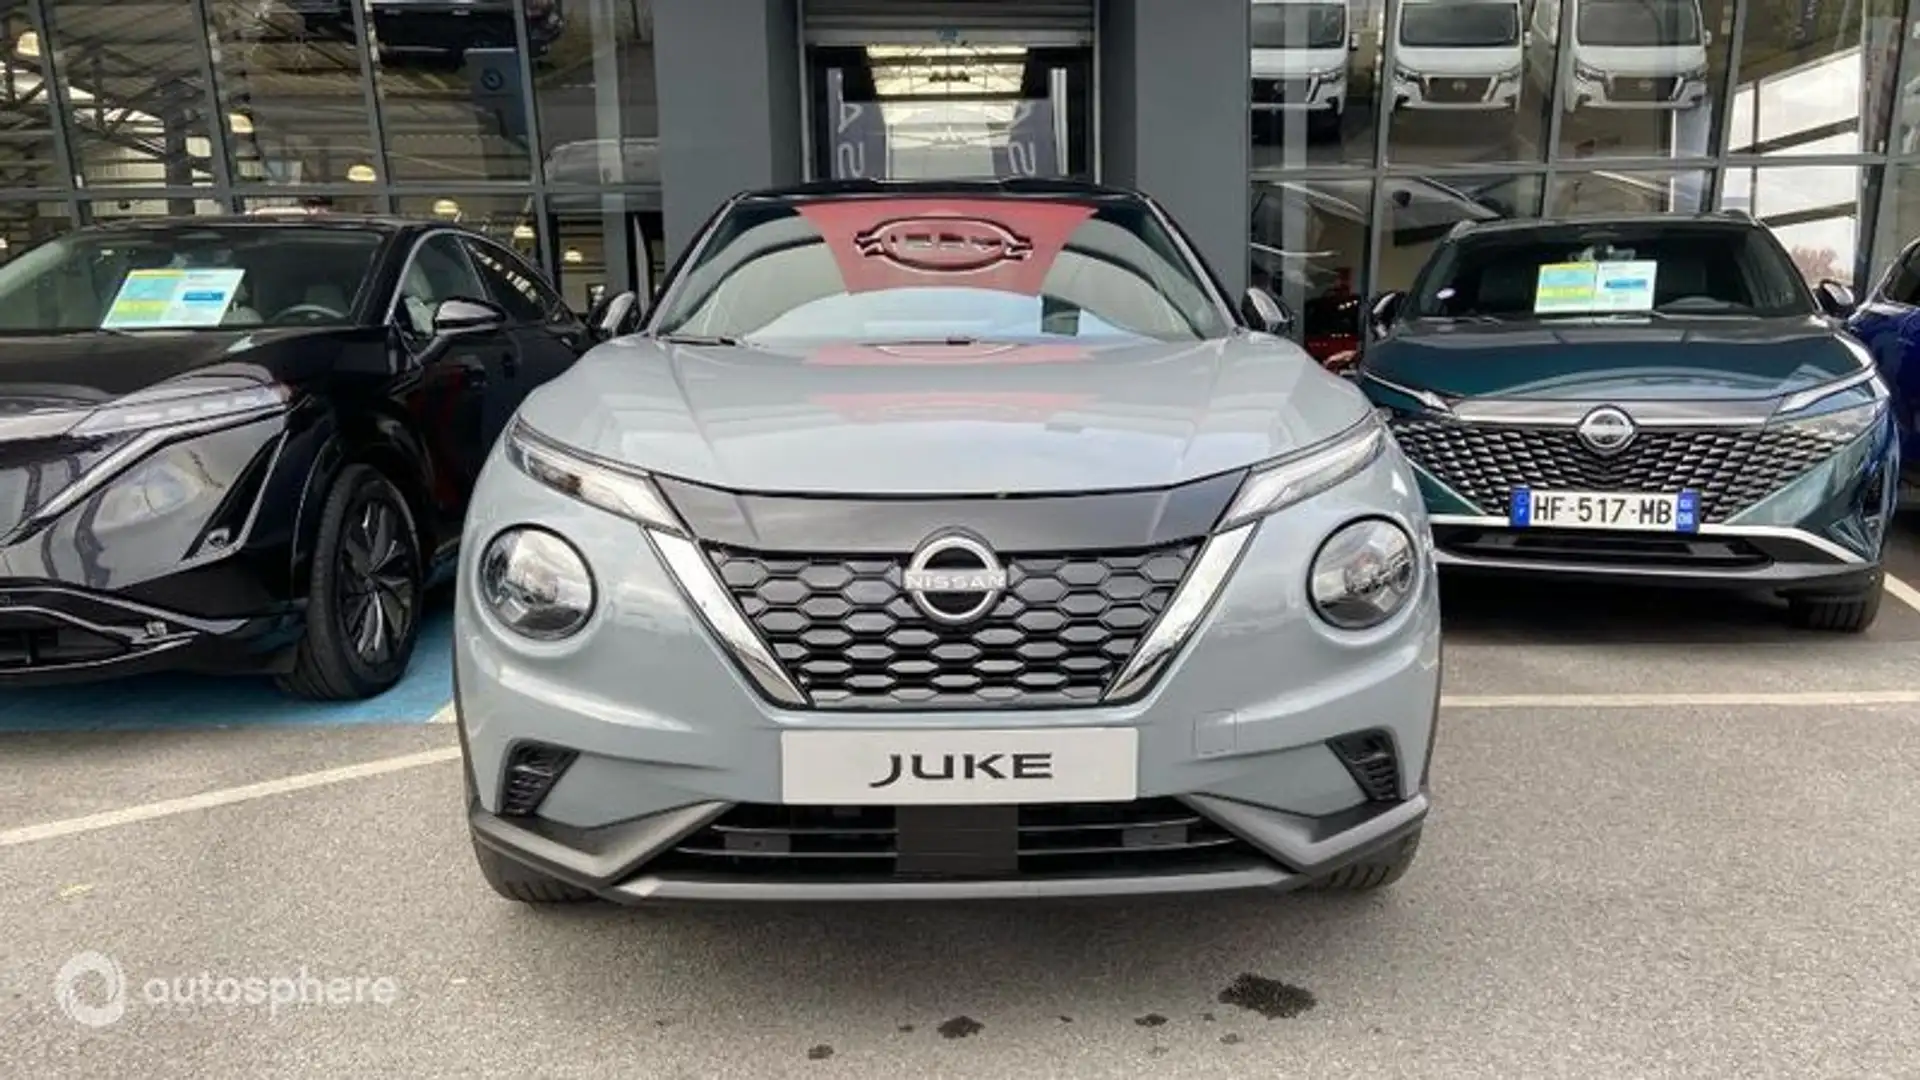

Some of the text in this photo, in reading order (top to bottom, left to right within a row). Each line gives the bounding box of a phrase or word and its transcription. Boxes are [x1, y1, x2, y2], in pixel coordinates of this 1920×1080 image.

[1533, 495, 1672, 525] HF-517-MB
[904, 575, 1006, 591] NISSAN
[868, 753, 1054, 788] JUKE
